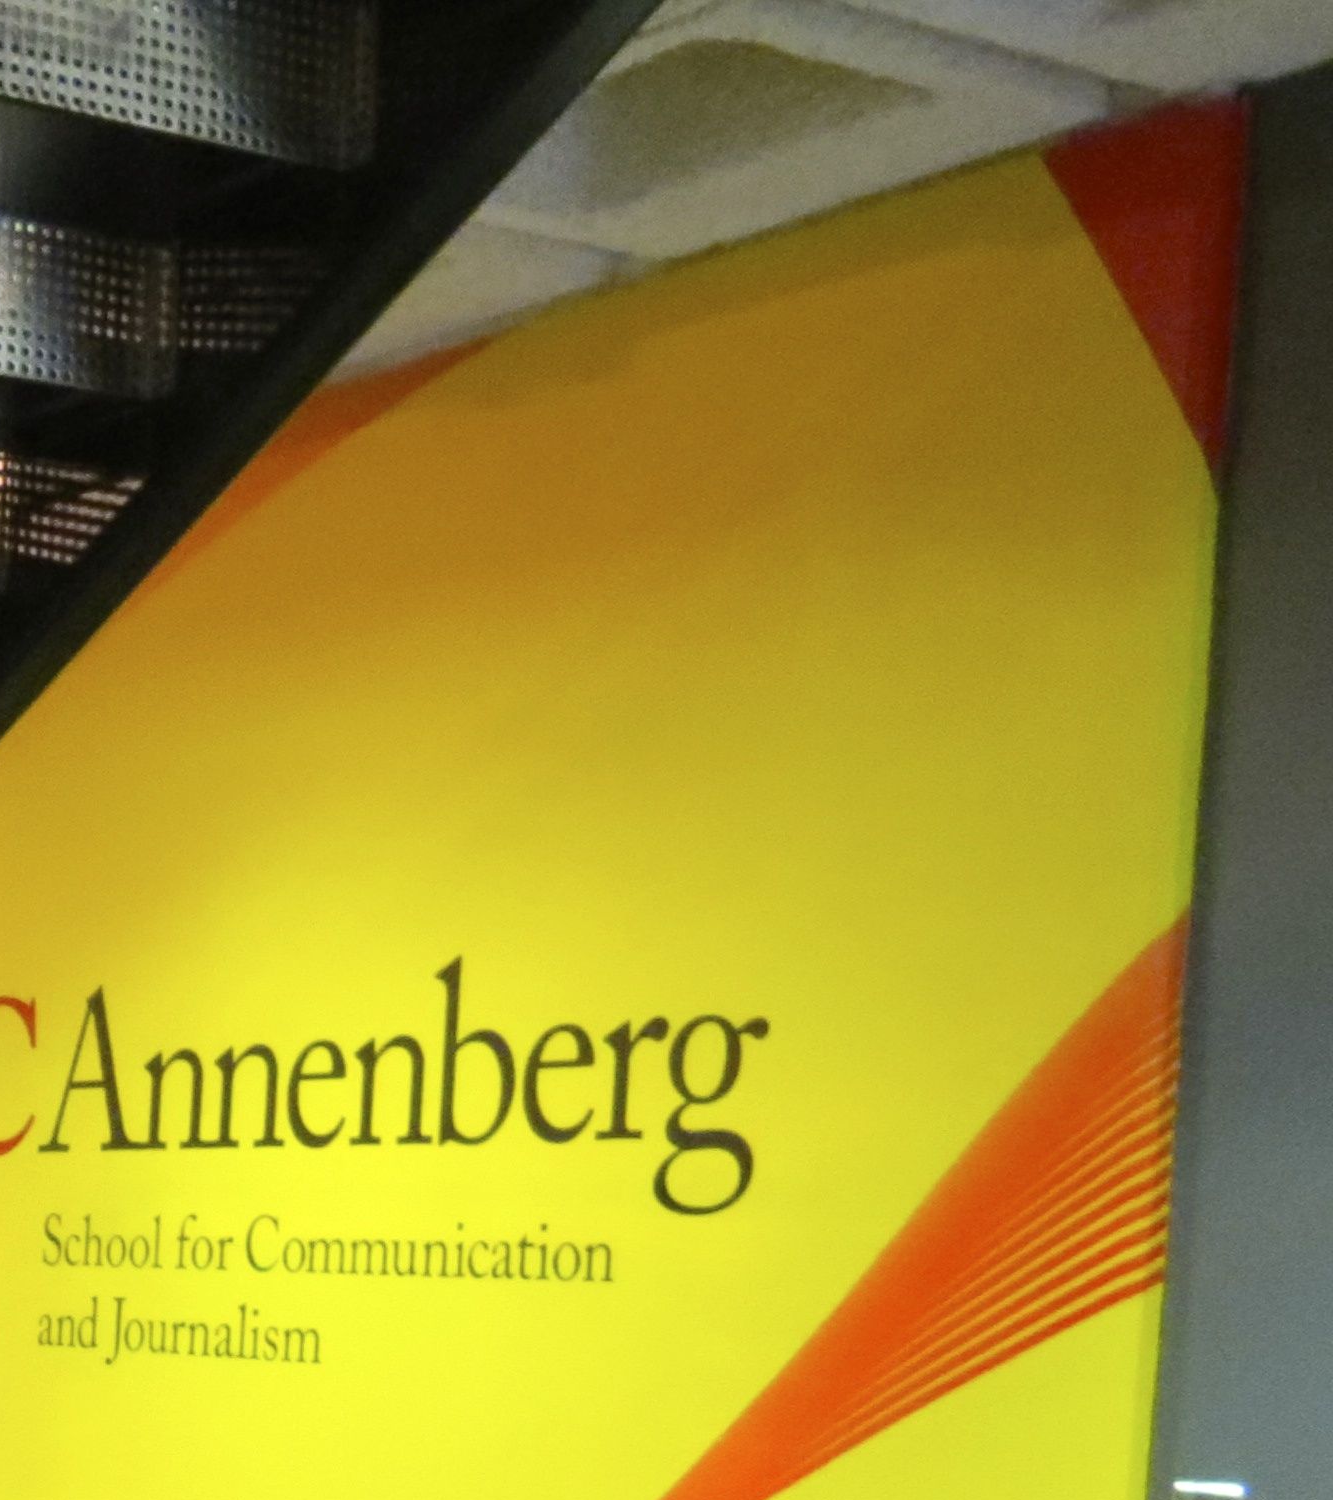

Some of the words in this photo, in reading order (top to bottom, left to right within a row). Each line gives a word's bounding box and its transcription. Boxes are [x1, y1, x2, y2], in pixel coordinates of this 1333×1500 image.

[42, 1212, 163, 1270] School
[175, 1215, 234, 1271] for
[245, 1214, 615, 1283] Communication
[37, 1295, 98, 1349] and
[104, 1296, 321, 1366] Journalism
